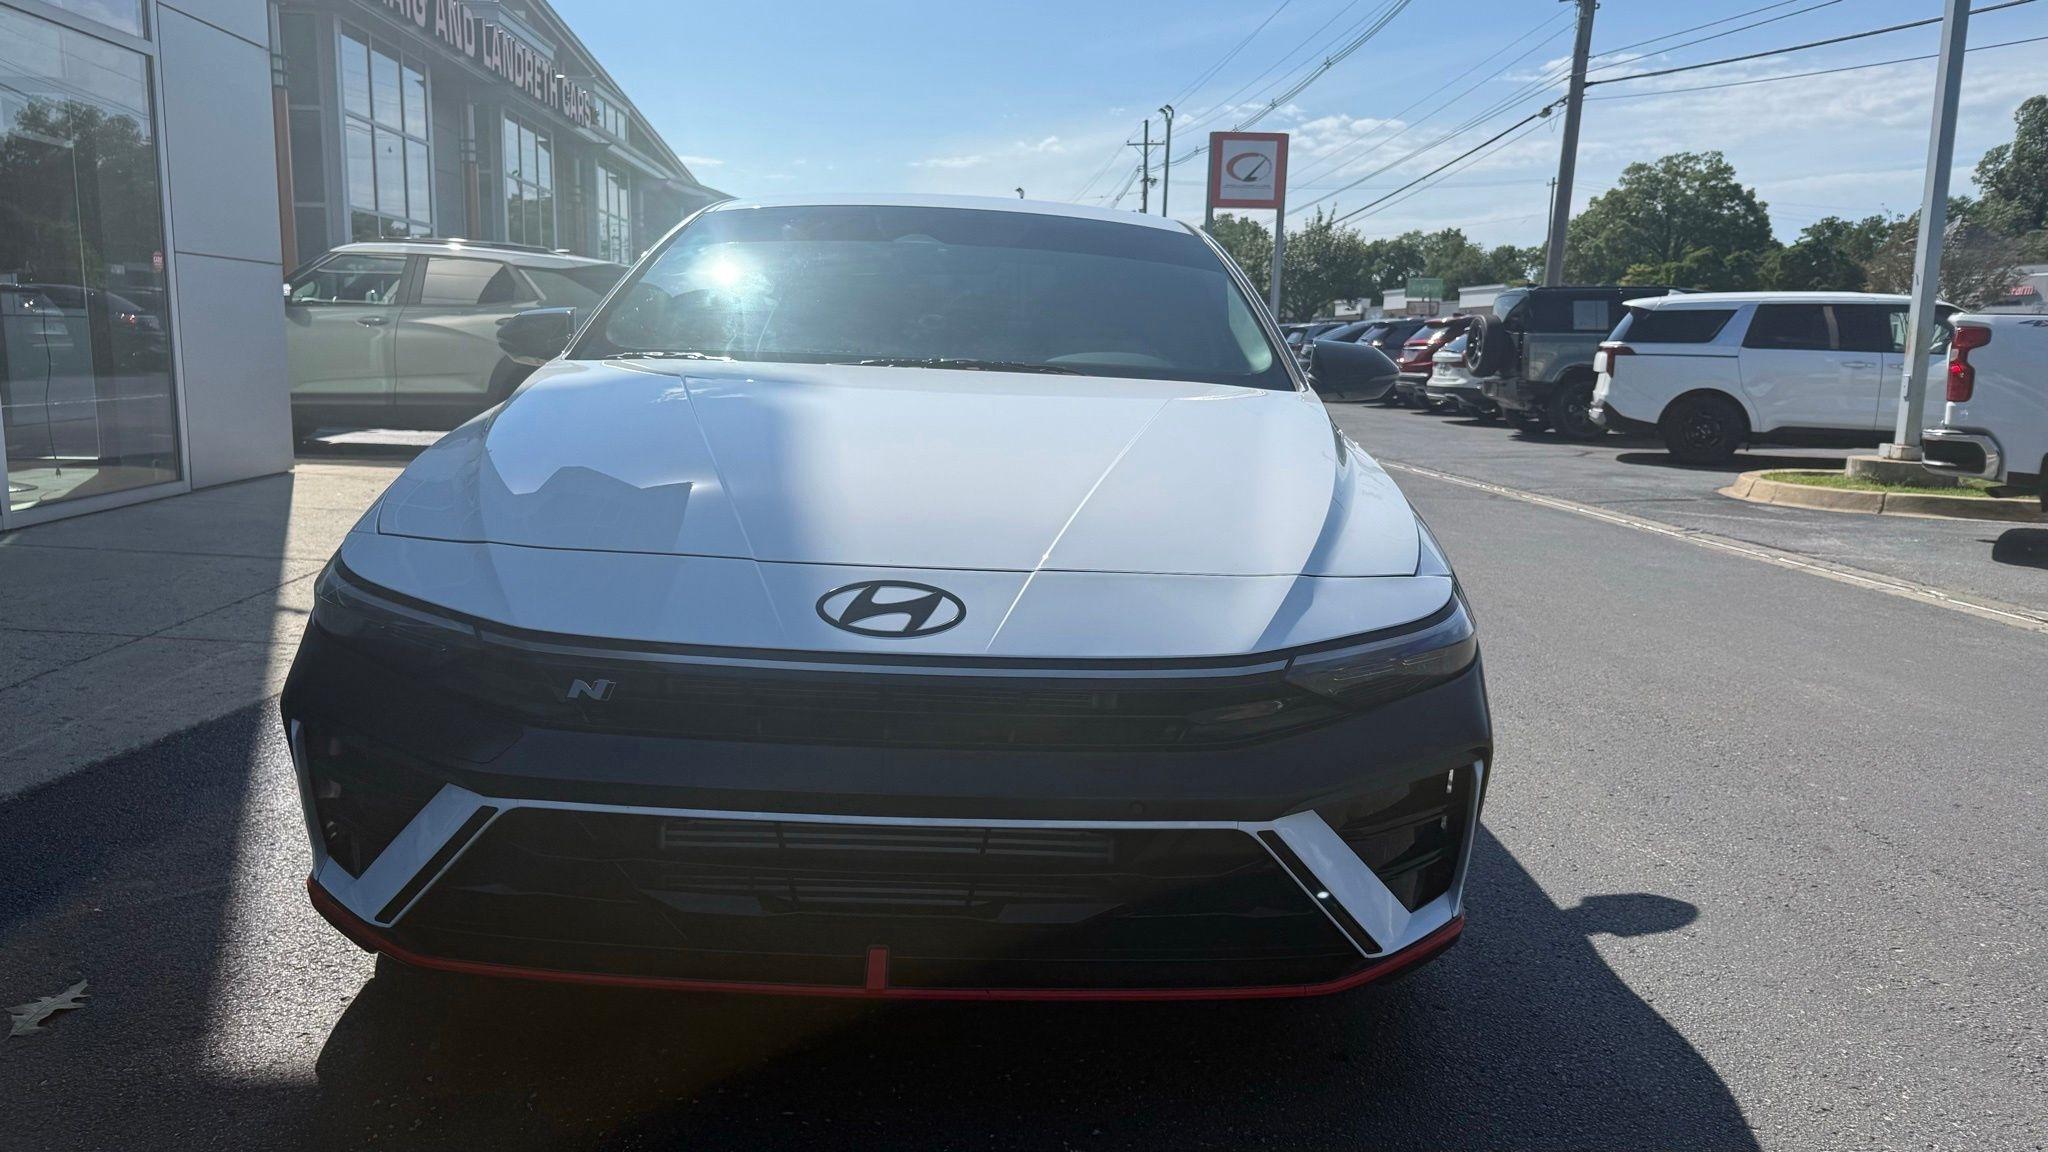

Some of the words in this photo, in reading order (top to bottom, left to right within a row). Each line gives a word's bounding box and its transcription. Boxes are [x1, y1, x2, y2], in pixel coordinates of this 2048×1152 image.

[435, 0, 475, 57] AND
[482, 19, 559, 110] LANDRETH
[562, 77, 592, 129] CARS
